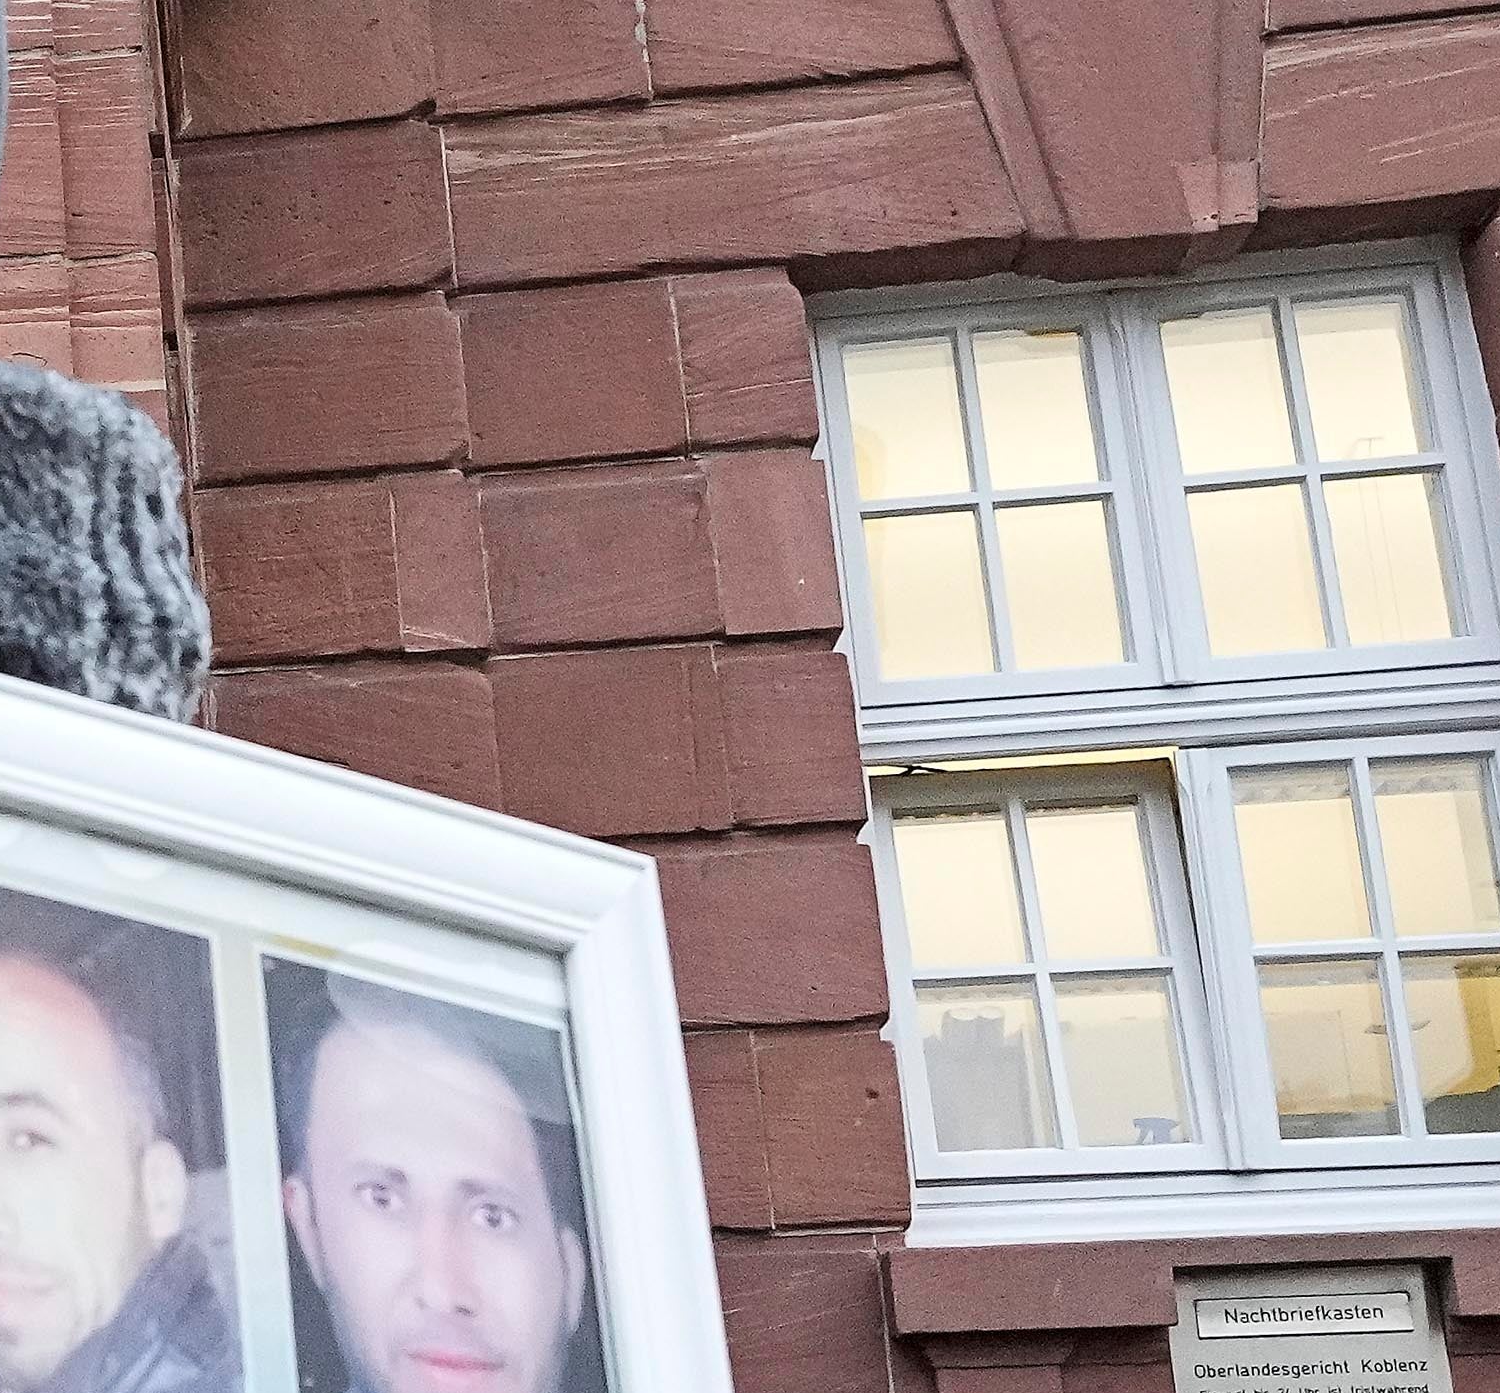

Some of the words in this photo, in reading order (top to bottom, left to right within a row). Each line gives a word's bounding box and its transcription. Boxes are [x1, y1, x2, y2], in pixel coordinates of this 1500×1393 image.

[1224, 1304, 1384, 1324] Nachtbriefkasten
[1193, 1359, 1350, 1380] Oberlandesgericht
[1360, 1358, 1429, 1374] Koblenz
